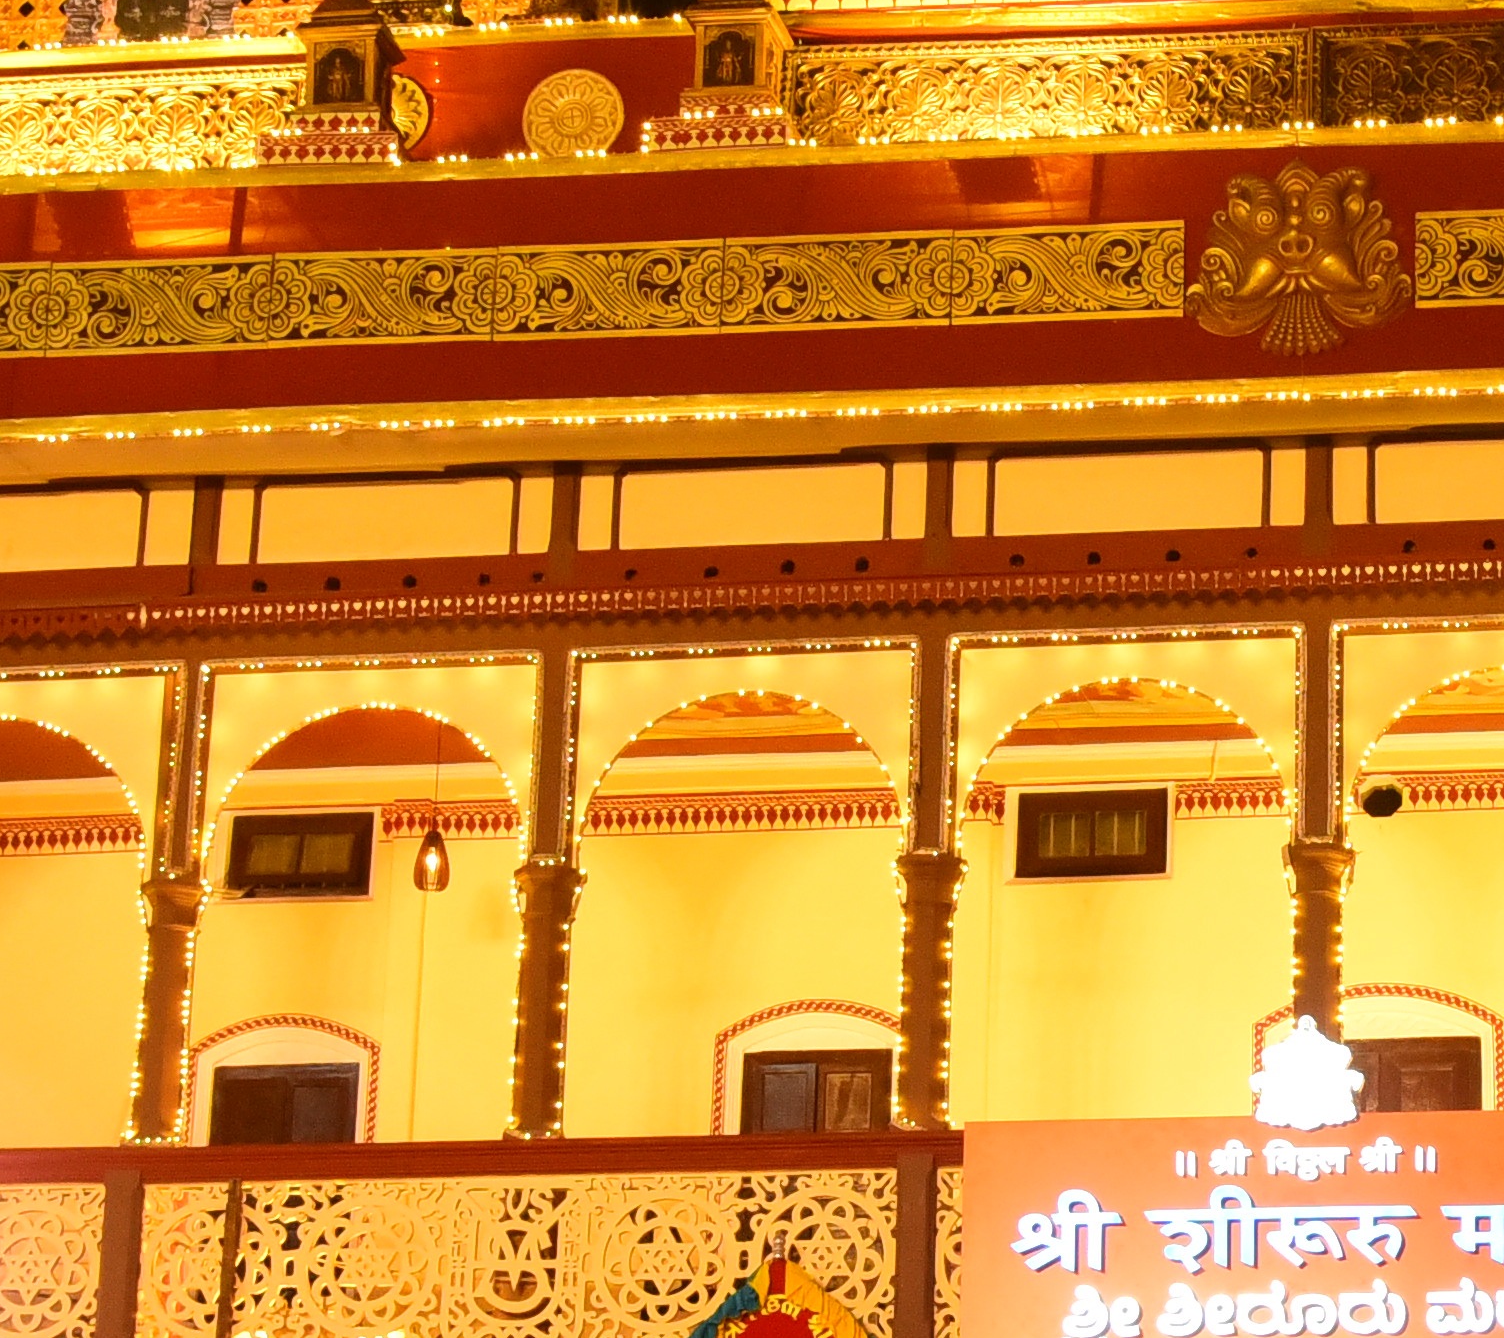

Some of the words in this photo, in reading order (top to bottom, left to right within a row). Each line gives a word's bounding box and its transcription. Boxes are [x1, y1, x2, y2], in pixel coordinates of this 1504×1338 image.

[1208, 1137, 1254, 1177] श्री
[1358, 1136, 1404, 1173] श्री
[1010, 1189, 1125, 1272] श्री
